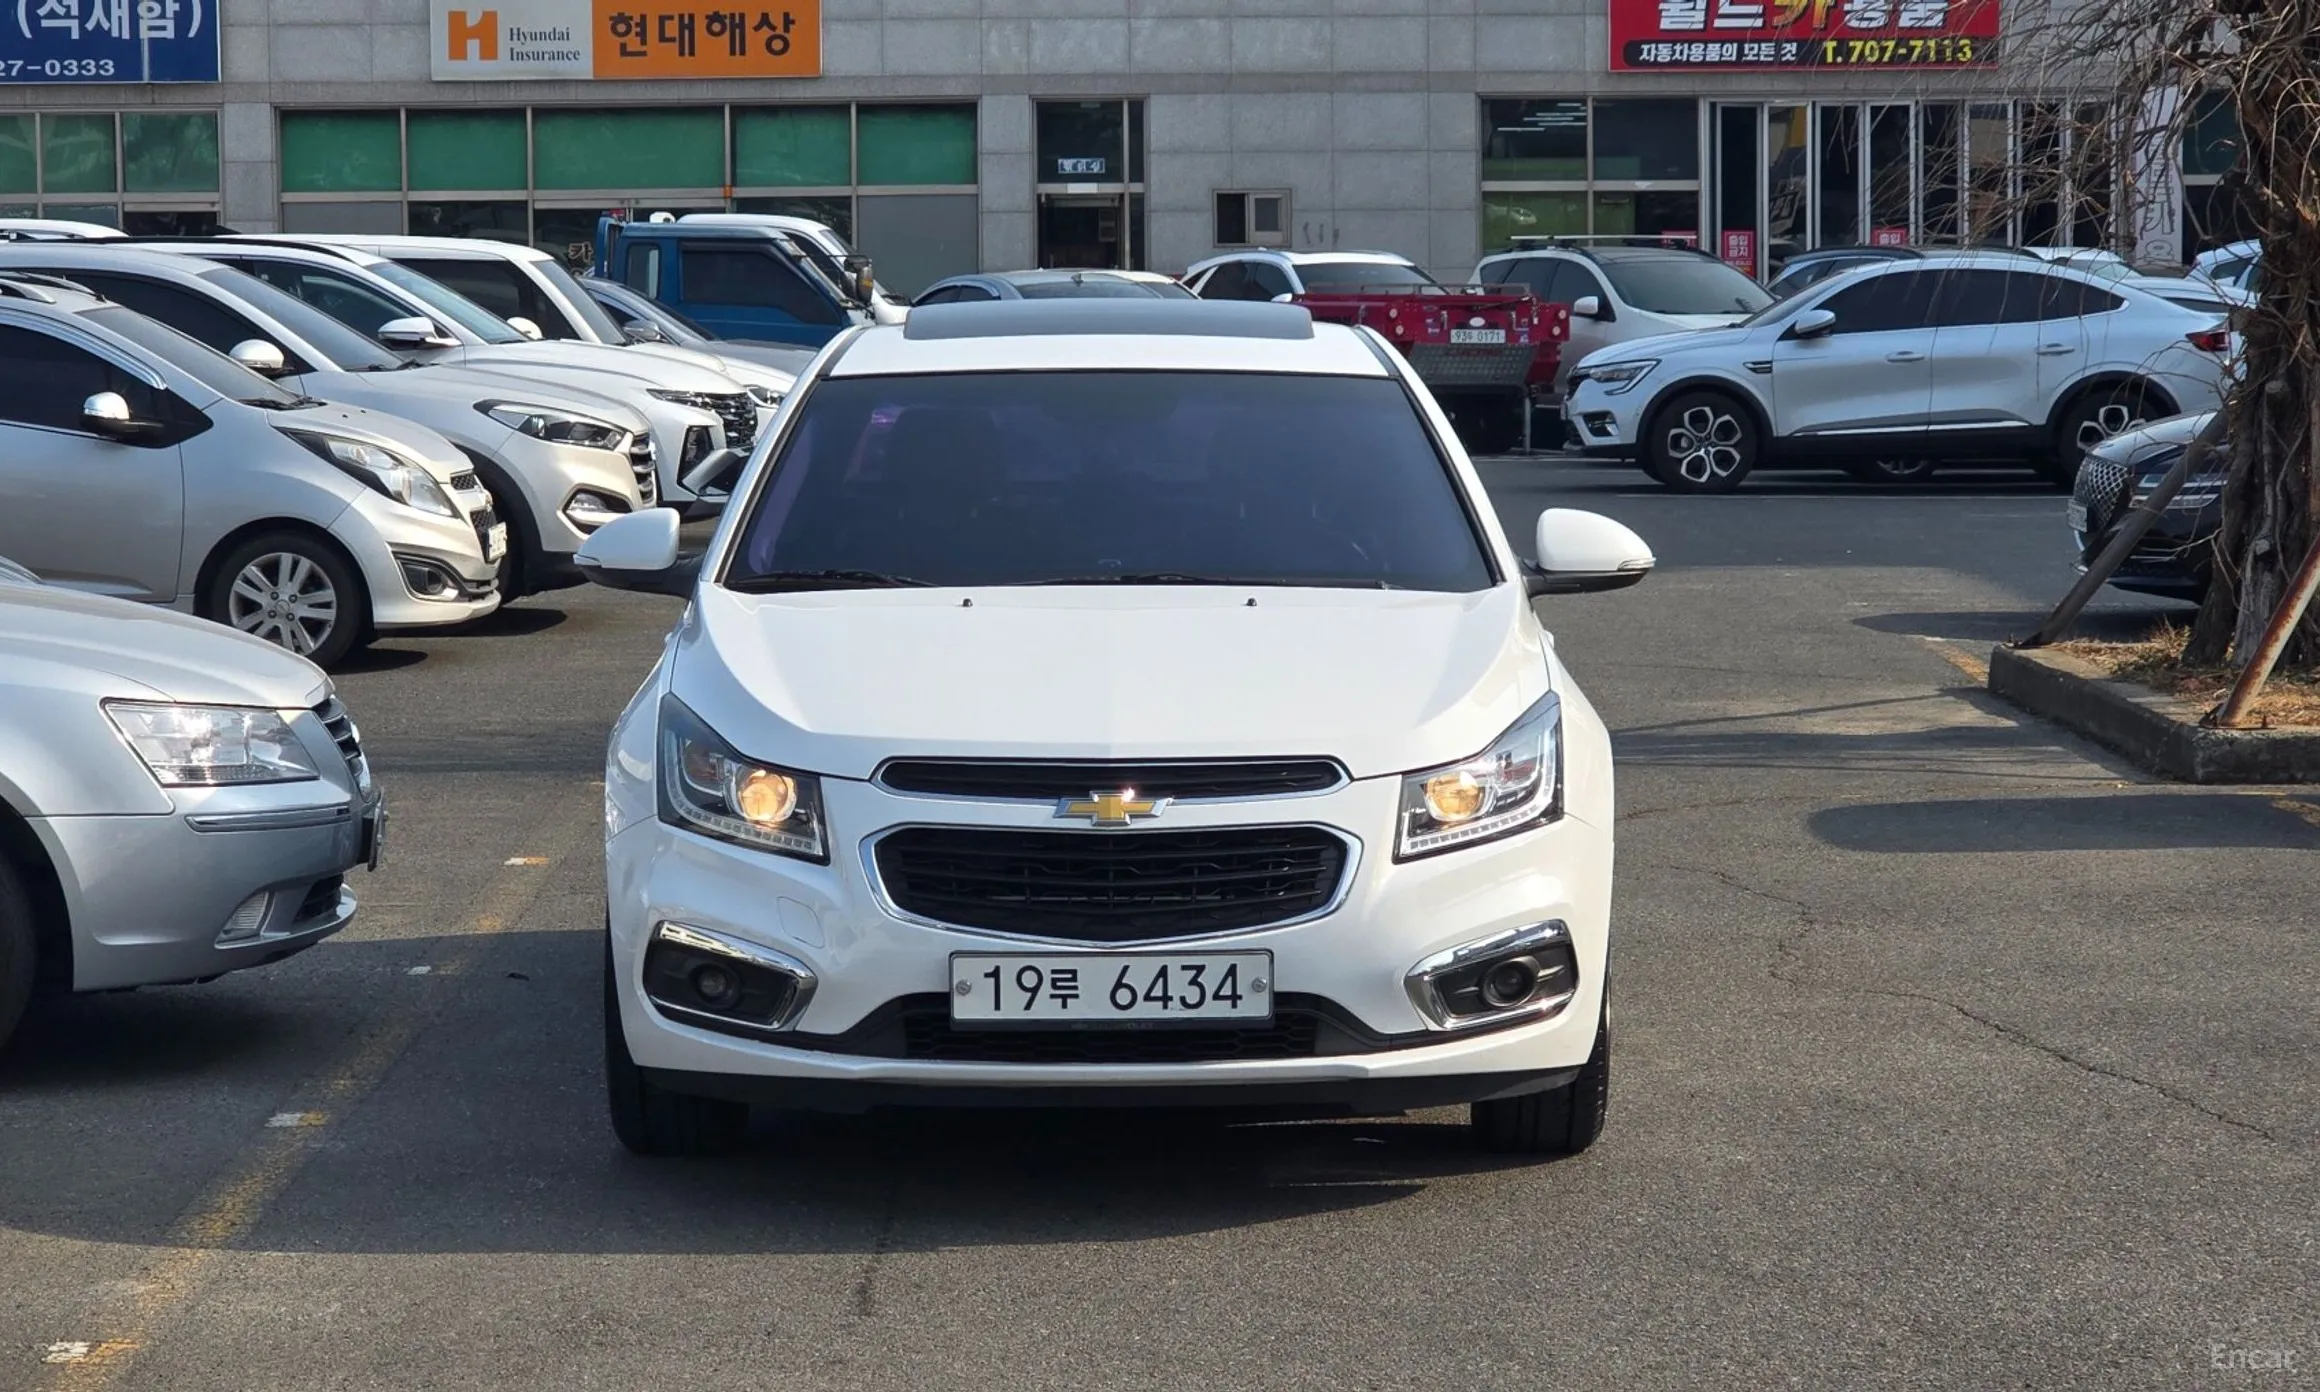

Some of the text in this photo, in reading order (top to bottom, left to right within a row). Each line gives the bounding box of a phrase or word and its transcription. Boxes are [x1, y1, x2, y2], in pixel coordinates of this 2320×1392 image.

[509, 26, 570, 45] Hyundai
[609, 11, 796, 57] 현대해상
[509, 47, 581, 61] Insurance
[1640, 42, 1738, 62] 자동차용품의
[1743, 43, 1776, 62] 모든
[1780, 42, 1798, 62] 것
[1477, 331, 1500, 342] 0171
[984, 963, 1243, 1012] 19루 6434
